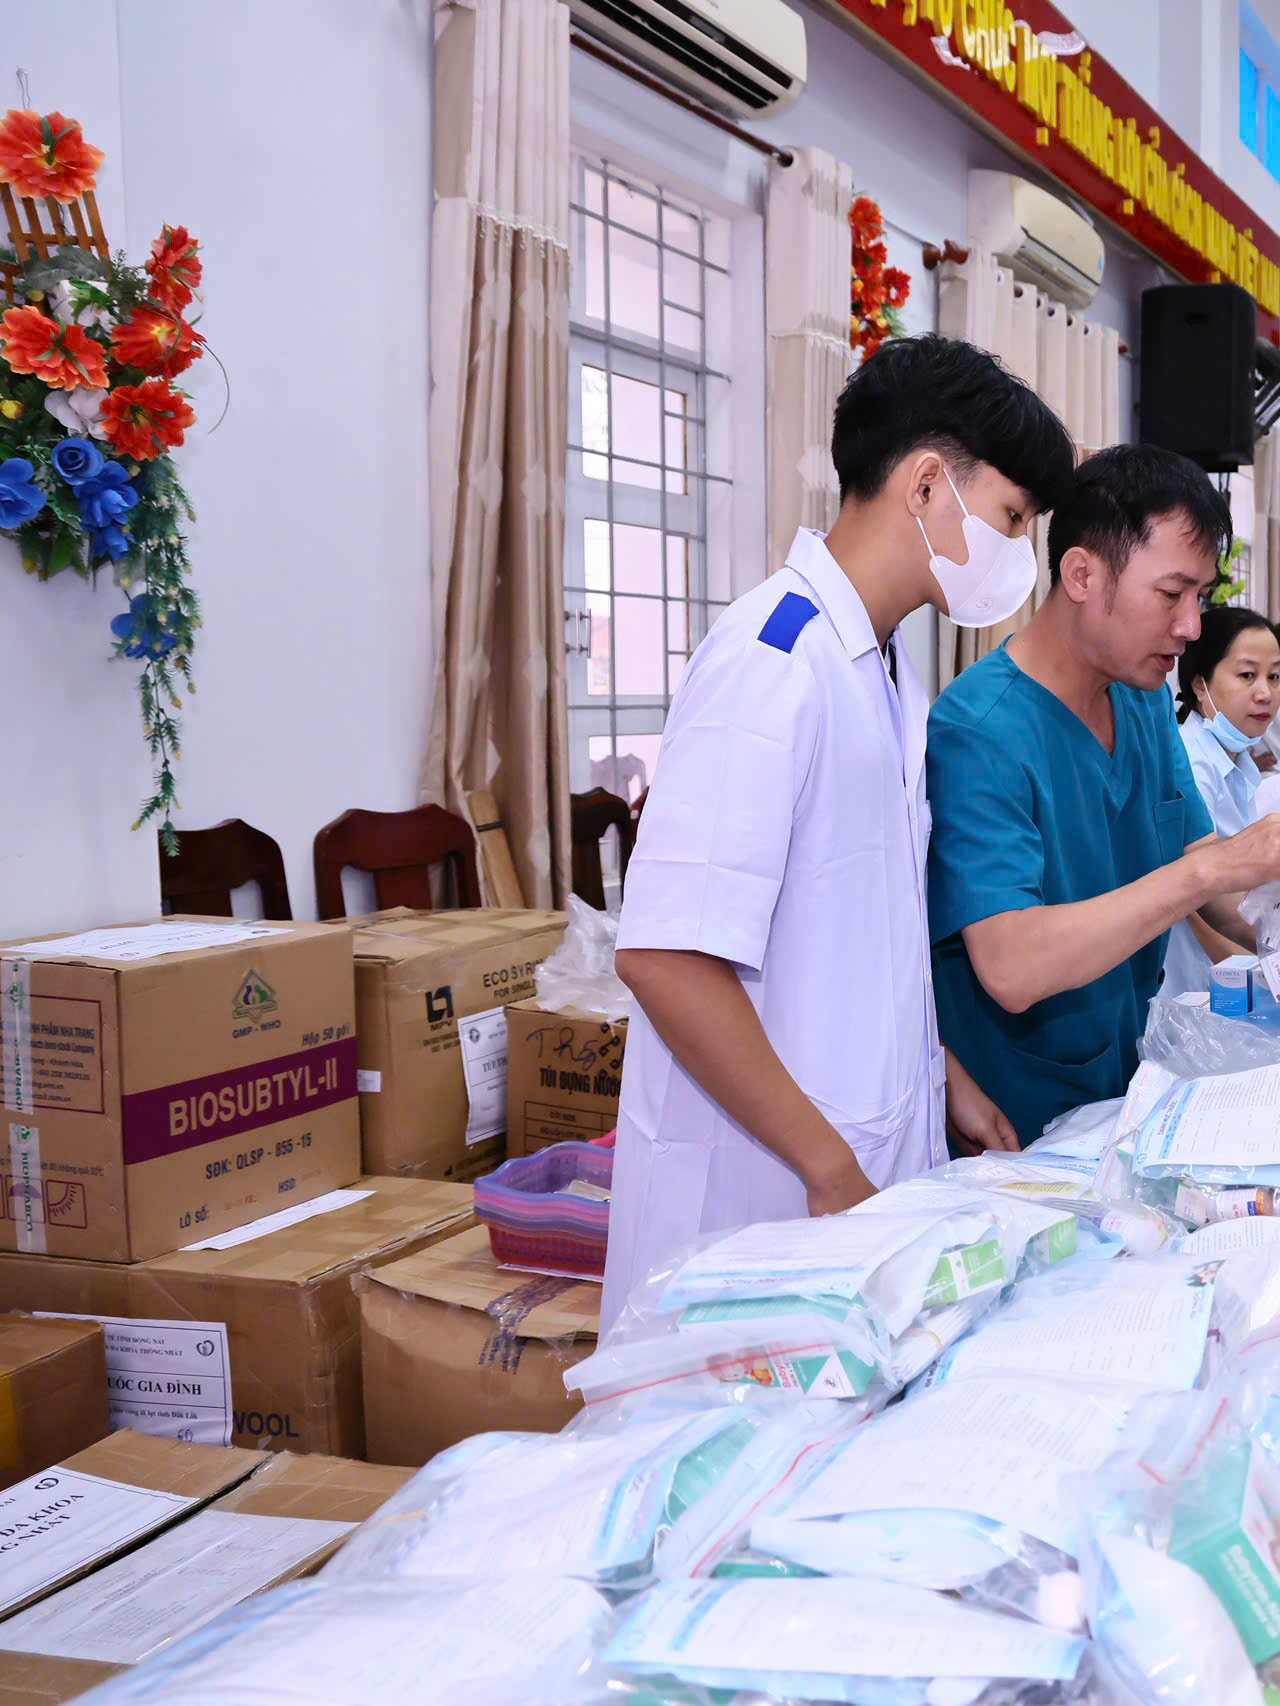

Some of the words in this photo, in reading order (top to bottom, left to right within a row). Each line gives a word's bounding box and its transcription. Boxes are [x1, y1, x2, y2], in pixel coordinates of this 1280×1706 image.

[482, 968, 509, 988] ECO
[232, 1025, 253, 1039] GMP
[169, 1057, 338, 1136] BIOSUBTYL-II
[236, 1147, 264, 1170] QLSP
[138, 1381, 163, 1393] GIA
[167, 1379, 202, 1396] ĐÌNH
[27, 1495, 85, 1521] KHOA
